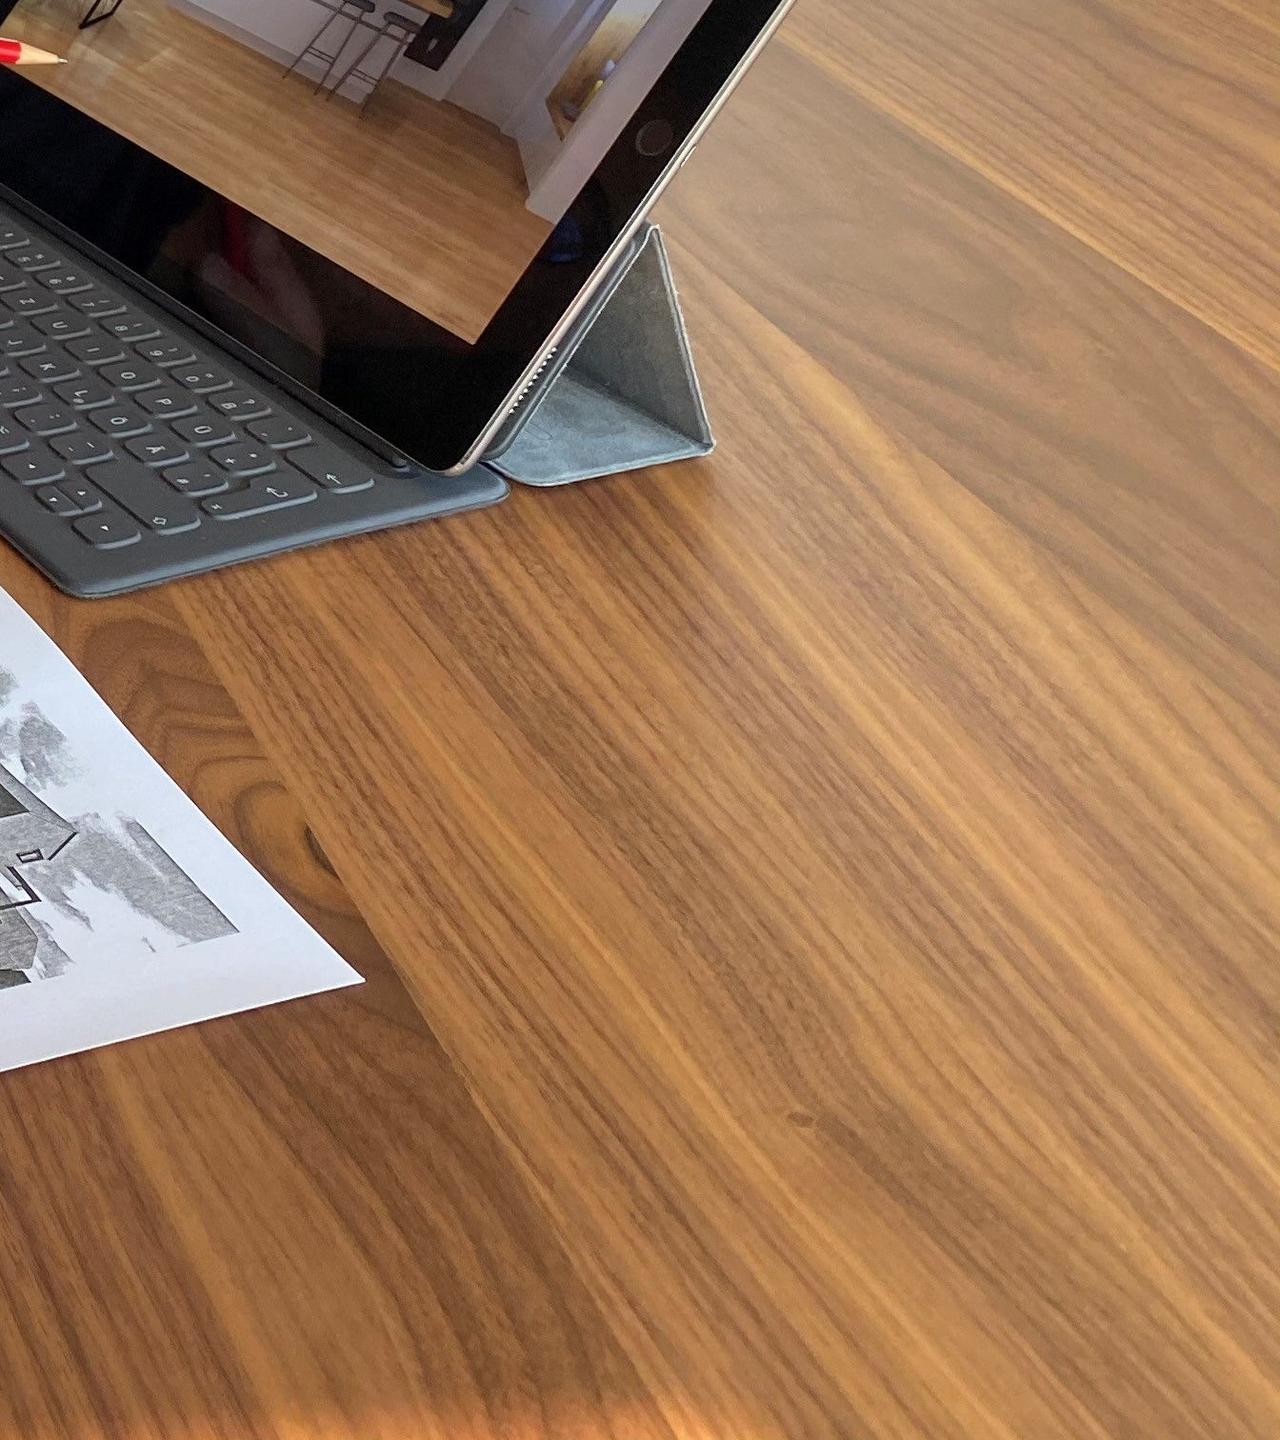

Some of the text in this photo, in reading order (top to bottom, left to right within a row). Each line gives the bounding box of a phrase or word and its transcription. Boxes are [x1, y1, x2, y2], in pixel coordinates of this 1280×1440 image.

[52, 321, 68, 329] U
[39, 363, 56, 371] K
[146, 446, 166, 454] Ä
